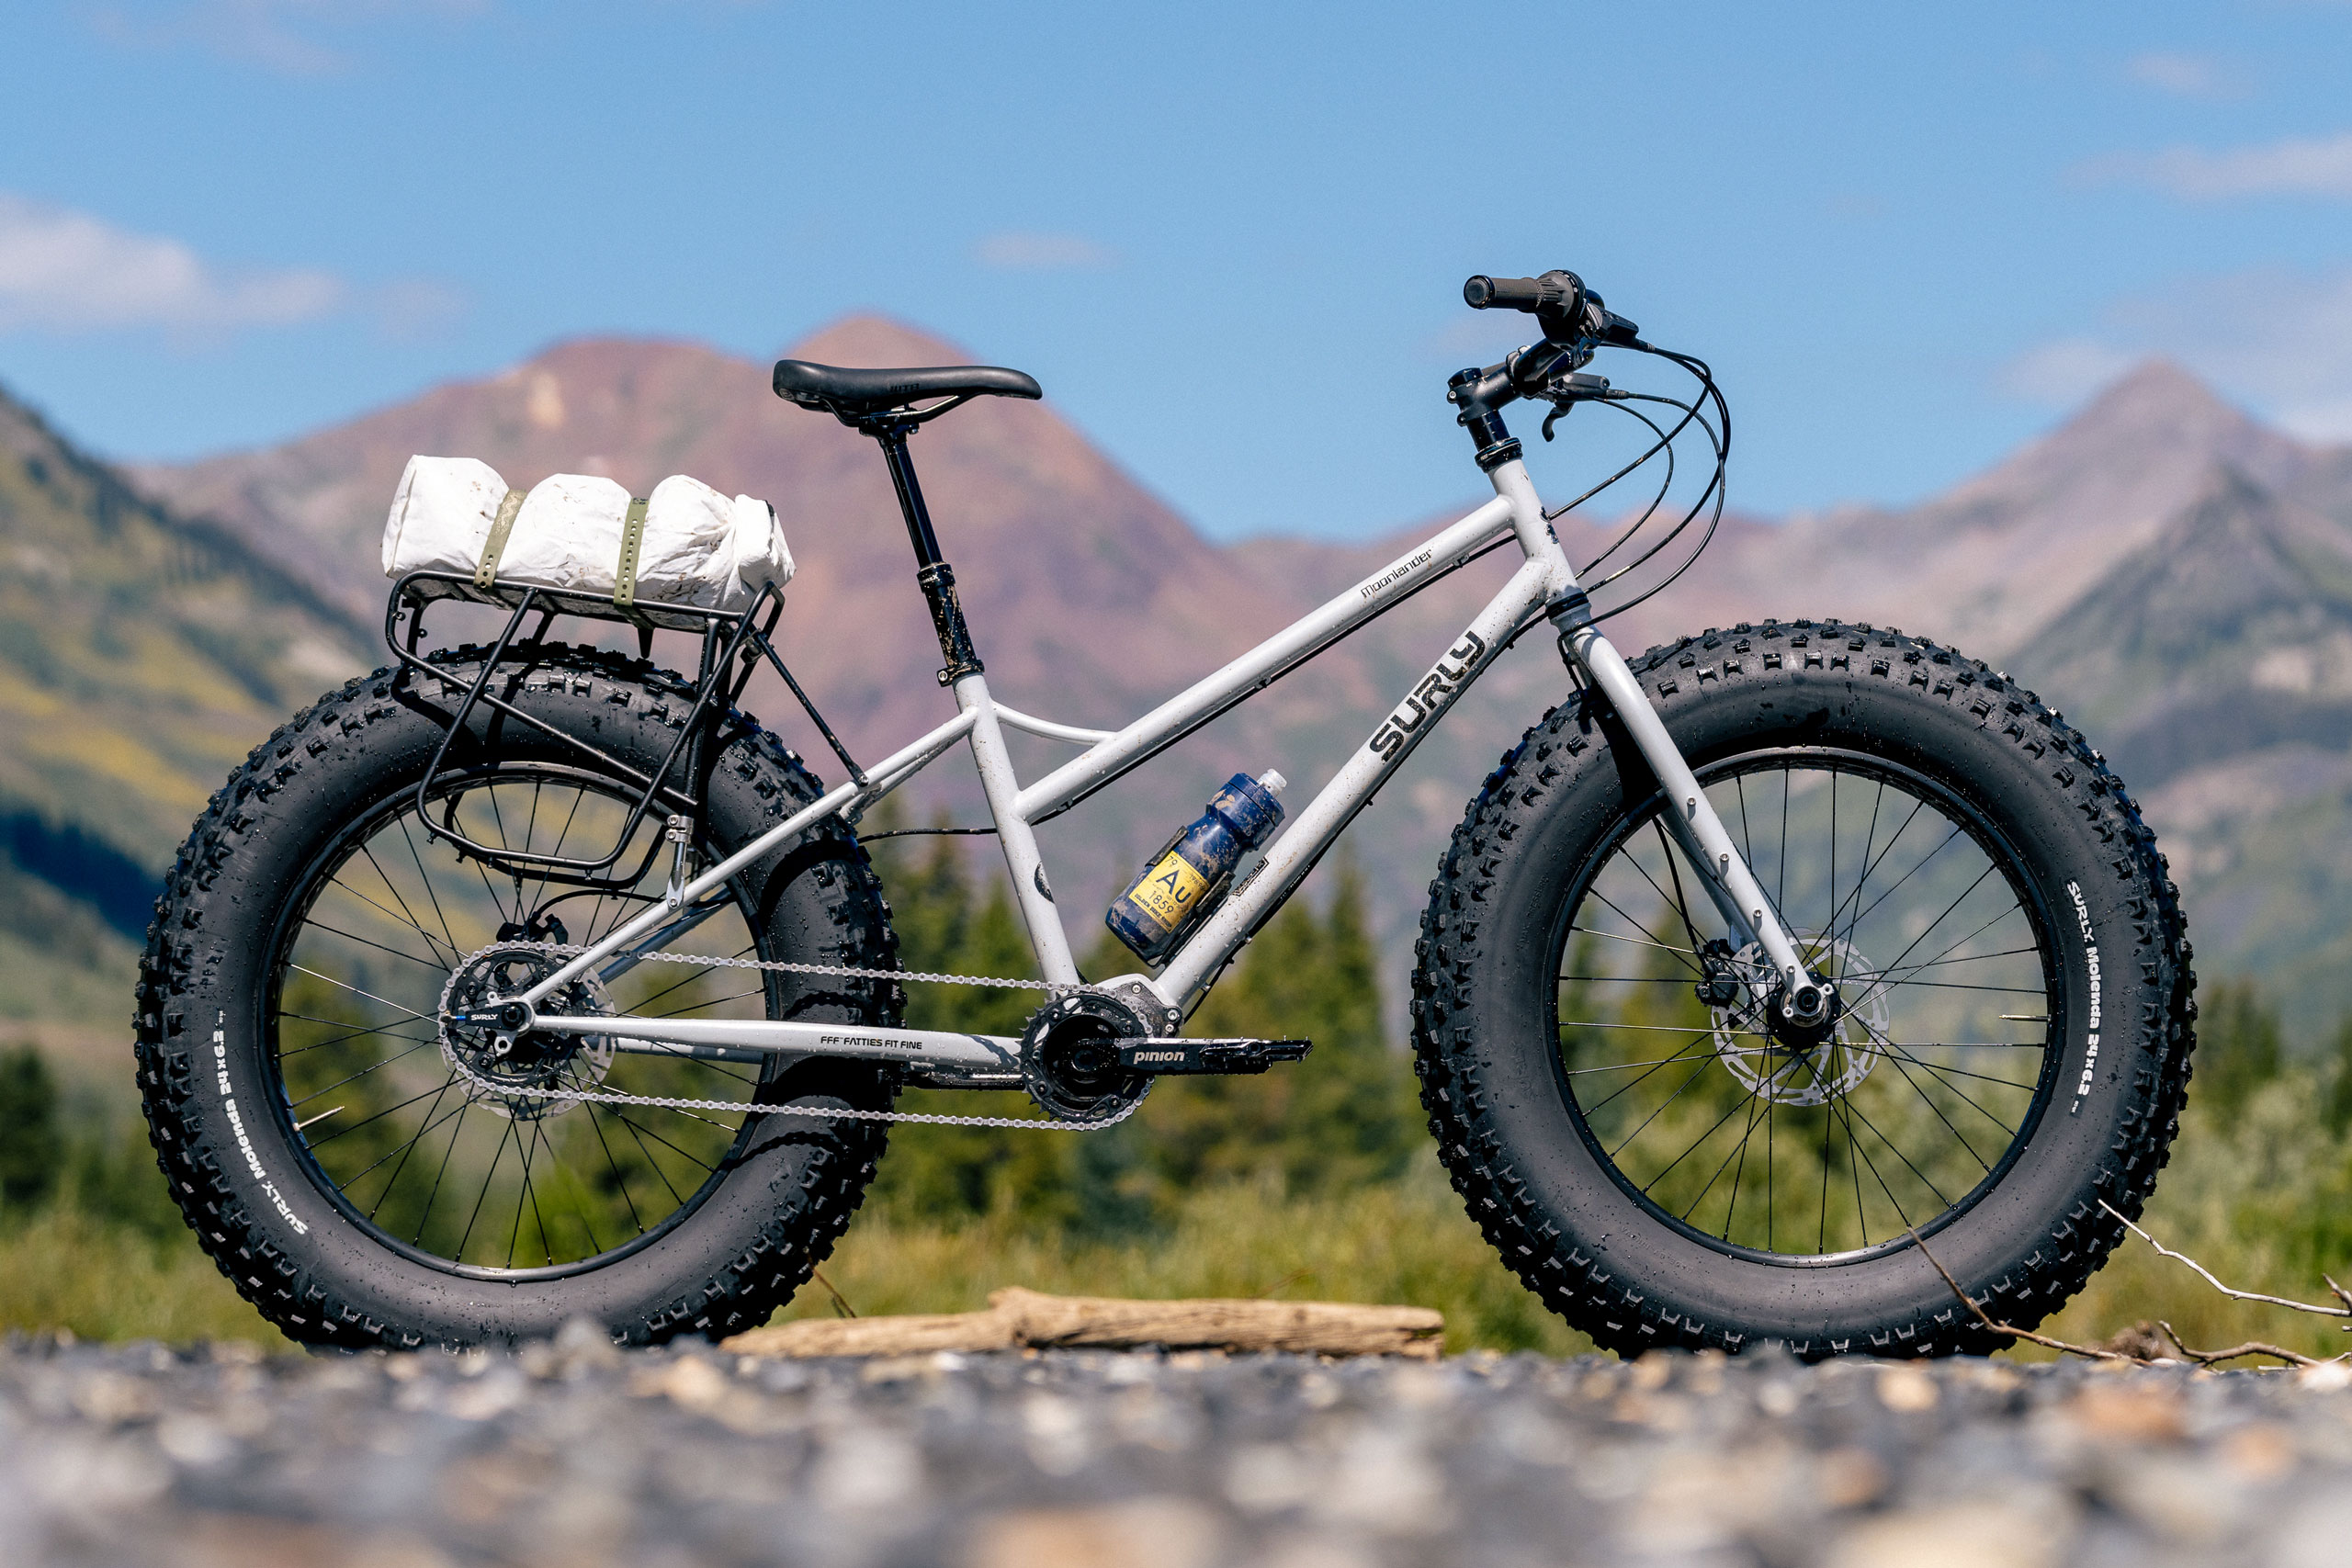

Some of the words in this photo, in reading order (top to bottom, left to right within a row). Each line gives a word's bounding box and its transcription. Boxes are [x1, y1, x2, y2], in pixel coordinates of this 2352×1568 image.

[1361, 549, 1432, 598] Moonlander
[1369, 630, 1486, 762] SURLY
[1165, 855, 1178, 867] 79
[1148, 890, 1174, 914] 1859
[1155, 869, 1192, 904] Au
[2086, 947, 2101, 1029] Molenda
[470, 1013, 498, 1021] SURLY
[843, 1037, 883, 1047] FATTIES
[885, 1040, 899, 1048] FIT
[900, 1041, 922, 1050] FINE
[225, 1099, 266, 1179] Molenda
